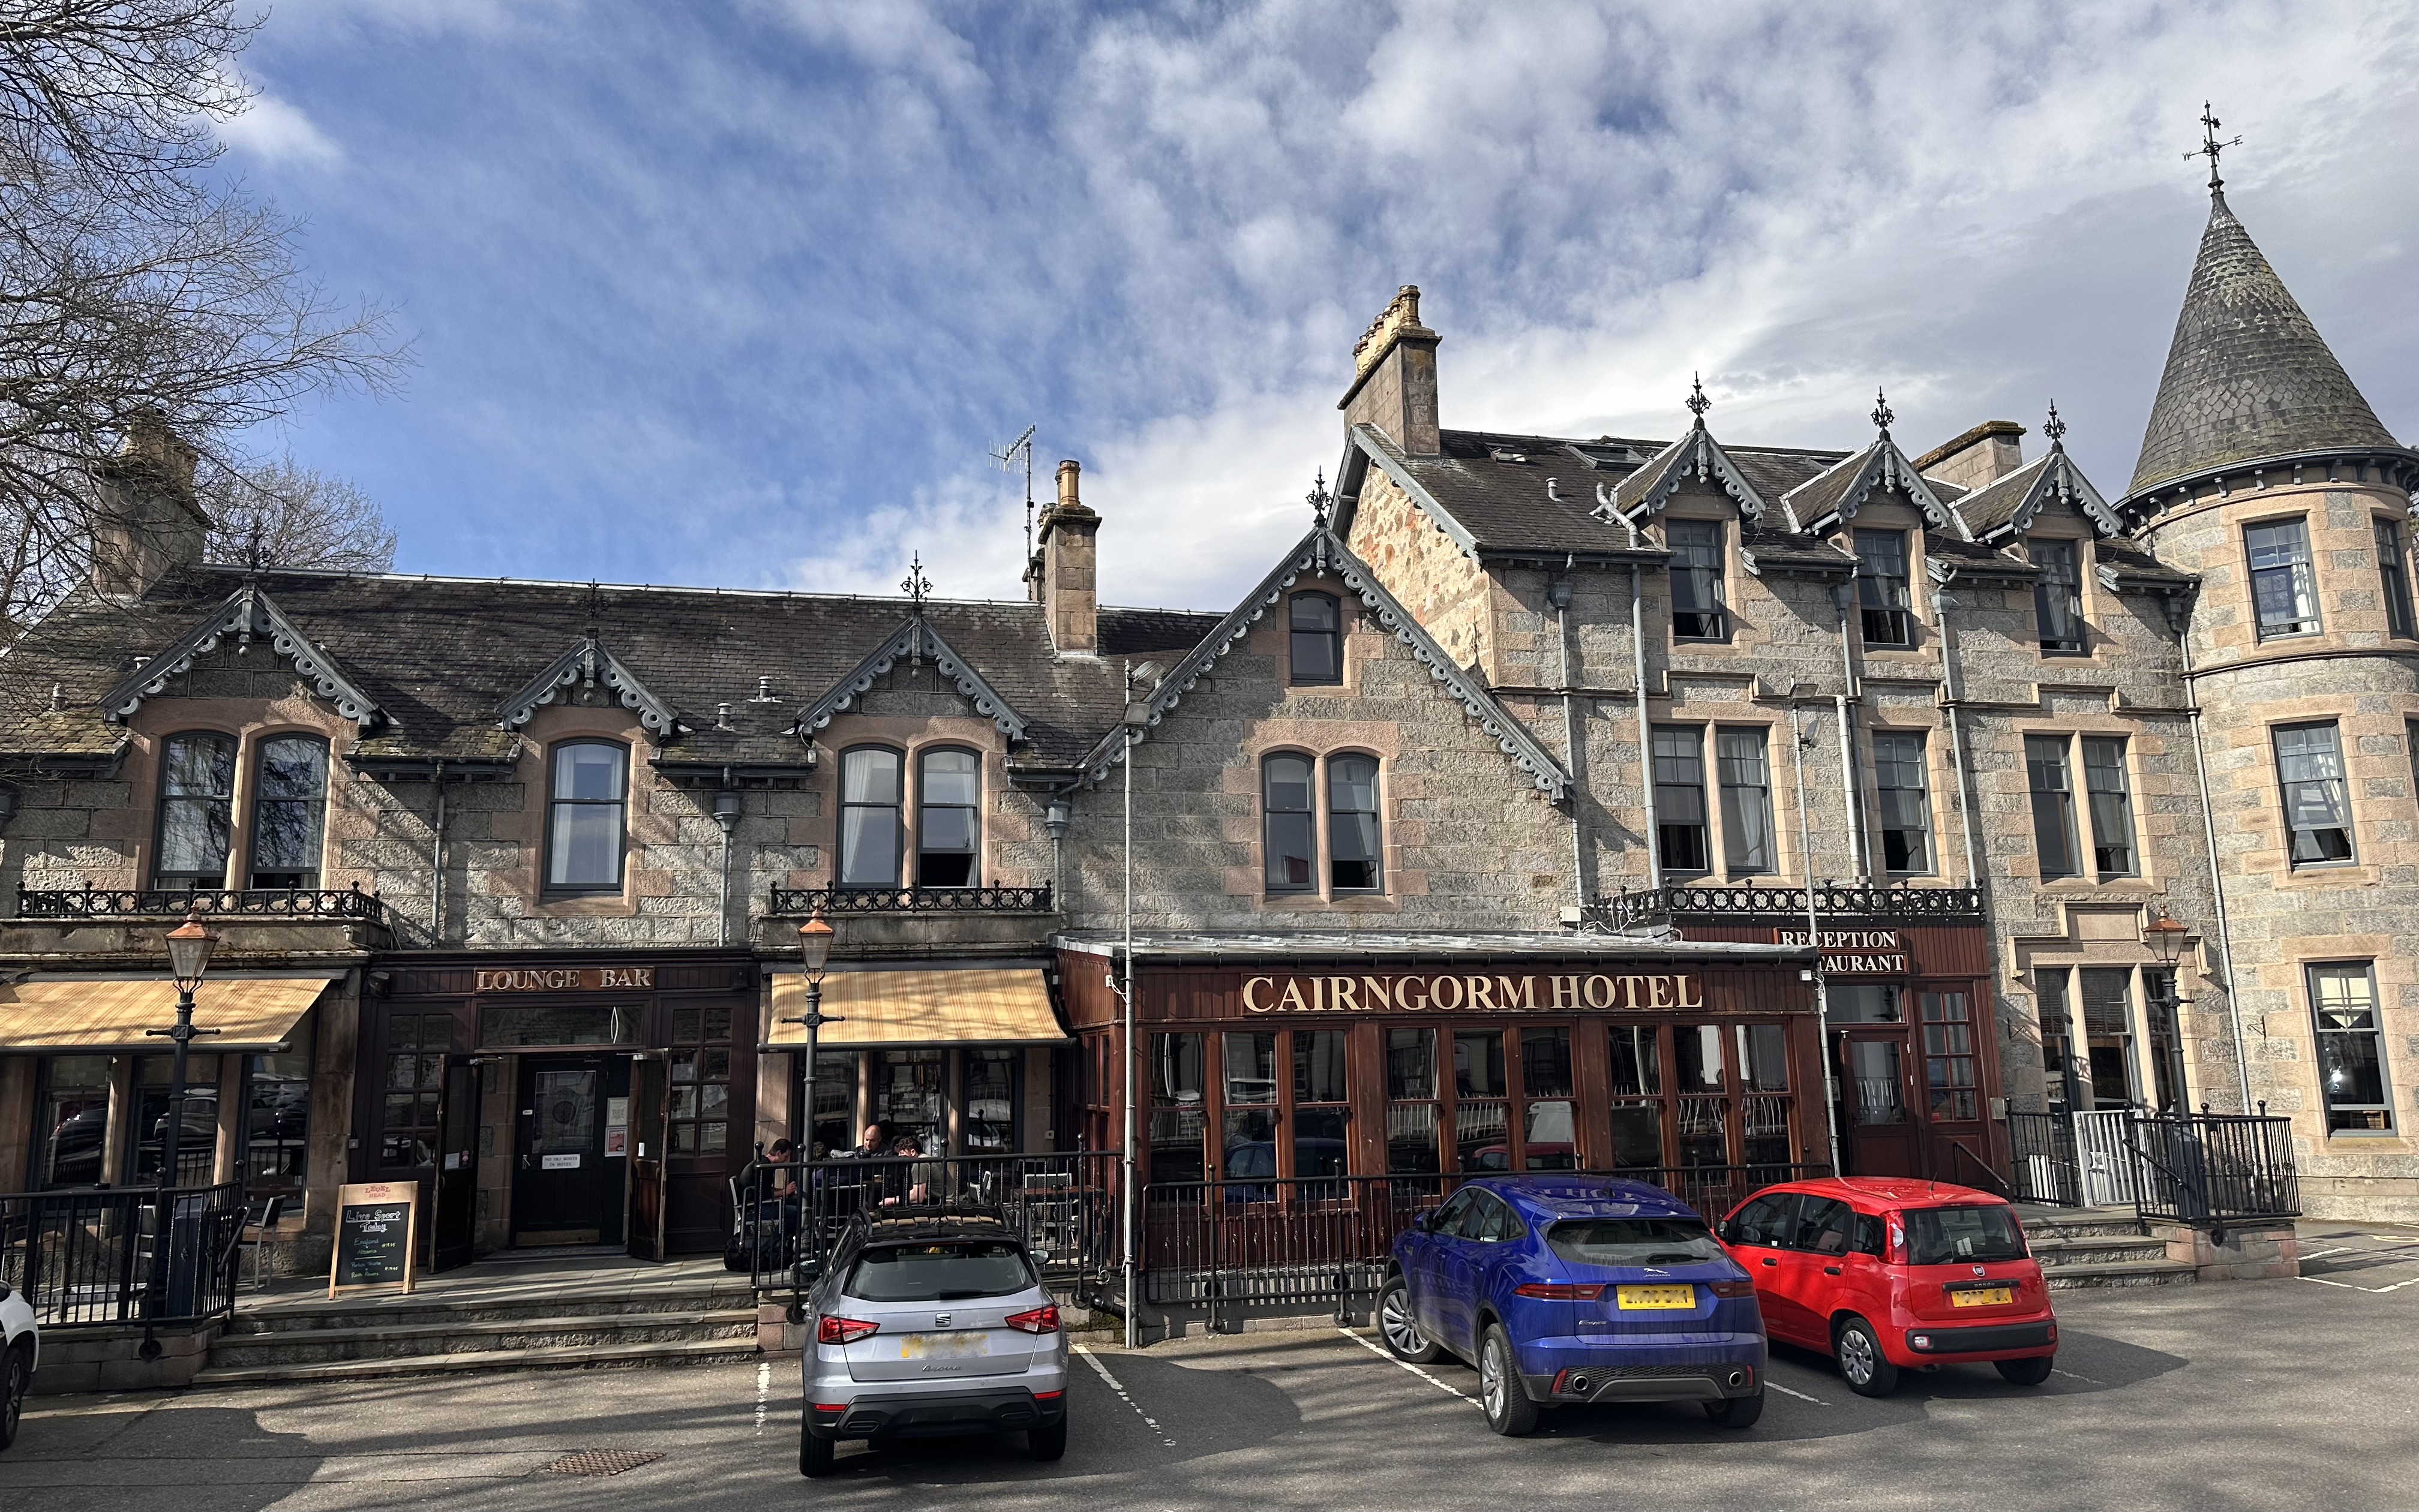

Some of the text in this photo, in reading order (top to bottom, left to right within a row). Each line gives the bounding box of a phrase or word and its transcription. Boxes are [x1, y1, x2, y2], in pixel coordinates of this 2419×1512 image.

[1781, 931, 1896, 948] RECEPTION
[476, 969, 651, 990] LOUNGE BAR
[1242, 975, 1703, 1012] CAIRNGORM HOTEL
[346, 1209, 401, 1222] Live Sport
[360, 1221, 387, 1233] Today
[354, 1237, 379, 1247] England
